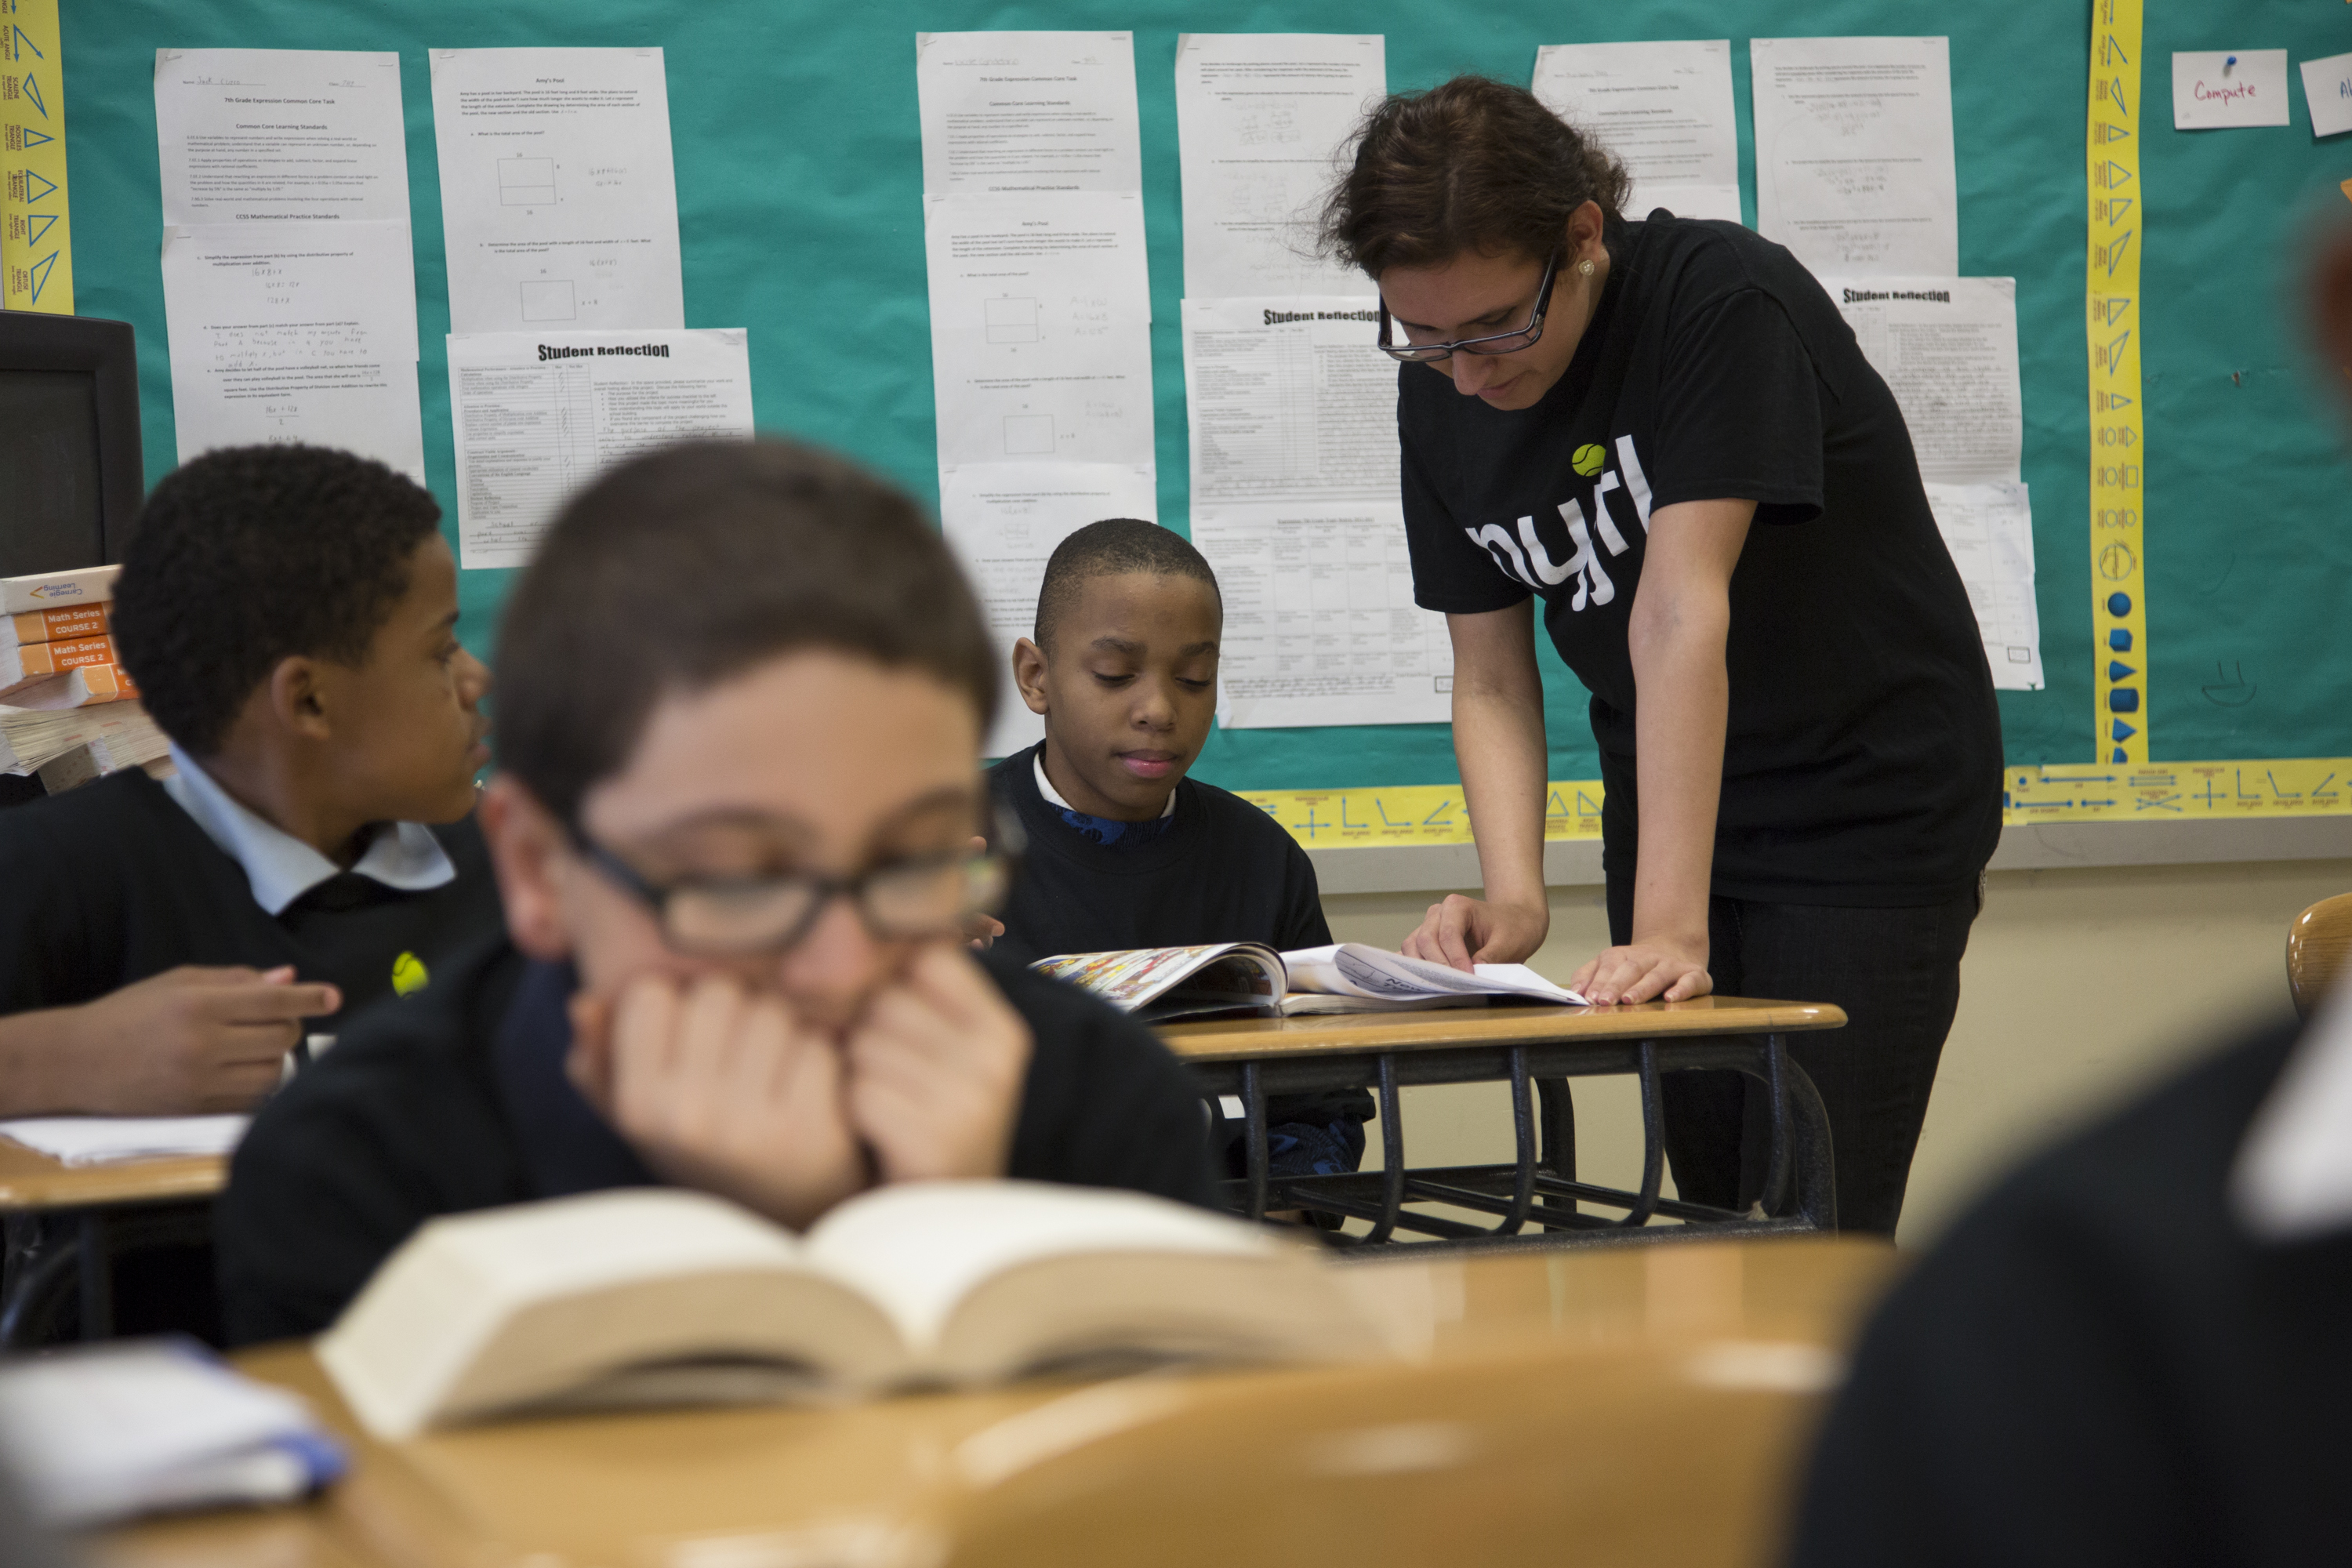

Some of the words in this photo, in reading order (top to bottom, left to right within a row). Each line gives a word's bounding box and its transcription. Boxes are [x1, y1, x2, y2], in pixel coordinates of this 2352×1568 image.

[2194, 80, 2256, 106] Compute
[1844, 288, 1890, 303] Student
[1893, 290, 1951, 303] Reflection
[1264, 309, 1314, 325] Student
[1318, 309, 1380, 322] Reflection
[538, 344, 594, 361] Student
[597, 344, 669, 358] Reflection
[44, 583, 76, 591] Learning
[49, 588, 82, 597] Carnegie
[48, 614, 71, 623] Math
[73, 610, 100, 620] Series
[56, 624, 90, 634] COURSE
[54, 646, 76, 655] Math
[78, 642, 105, 652] Series
[62, 656, 95, 666] COURSE
